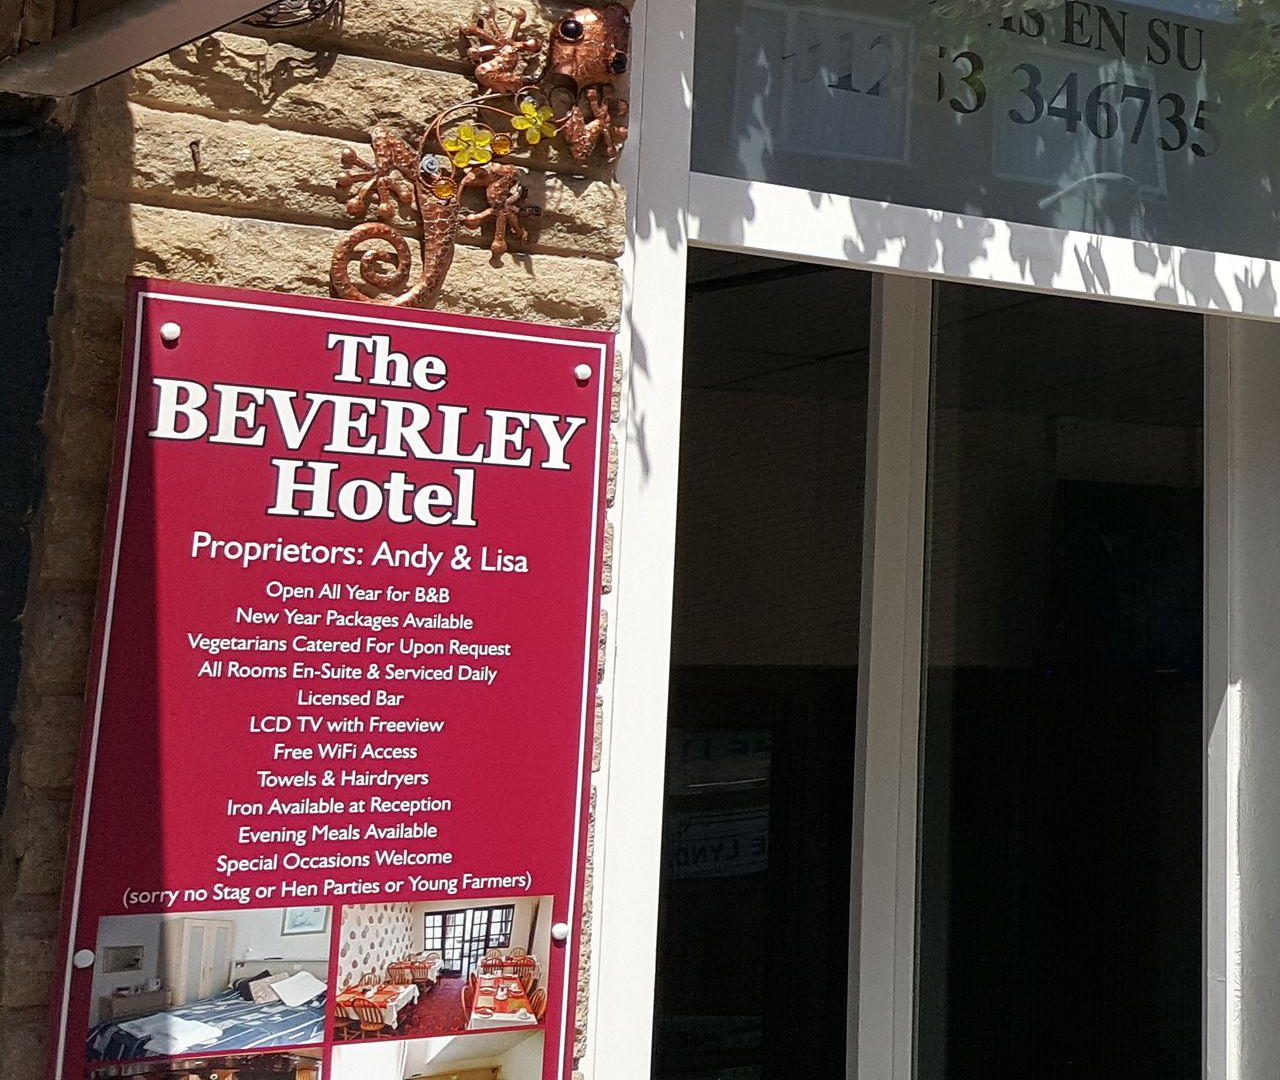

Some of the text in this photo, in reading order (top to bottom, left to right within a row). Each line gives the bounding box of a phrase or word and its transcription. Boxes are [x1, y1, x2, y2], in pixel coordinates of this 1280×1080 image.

[1060, 0, 1129, 56] EN
[1008, 63, 1219, 158] 346735
[328, 334, 446, 390] The
[149, 378, 586, 470] BEVERLEY
[267, 459, 476, 526] Hotel
[191, 531, 529, 576] Proprietors: Andy & Lisa
[266, 580, 450, 603] Open All Year for B&B
[236, 607, 474, 631] New Year Packages Available
[187, 632, 512, 659] Vegetarians Catered For Upon Request
[197, 661, 498, 685] All Rooms En-Suite & Serviced Daily
[298, 689, 405, 706] Licensed Bar
[250, 716, 445, 732] LCD TV with Freeview
[274, 743, 418, 760] Free WiFi Access
[256, 770, 429, 790] Towels & Hairdryers
[227, 796, 452, 816] Iron Available at Reception
[238, 822, 438, 846] Evening Meals Available
[216, 849, 452, 876] Special Occasions Welcome
[123, 870, 532, 909] (sorry no Stag or Hen Parties or Young Farmers)
